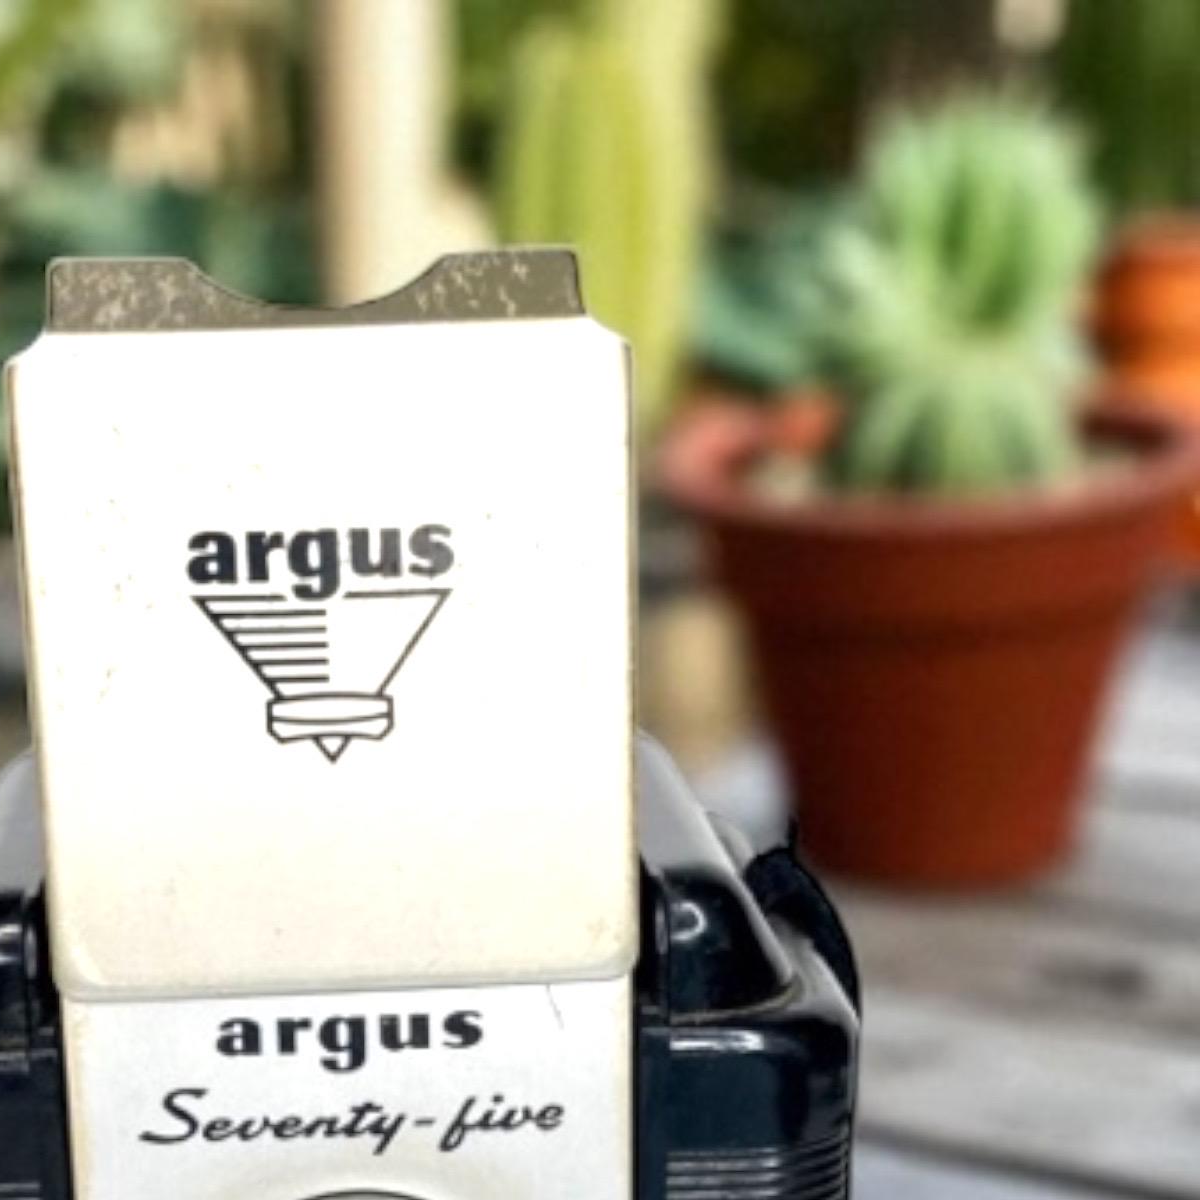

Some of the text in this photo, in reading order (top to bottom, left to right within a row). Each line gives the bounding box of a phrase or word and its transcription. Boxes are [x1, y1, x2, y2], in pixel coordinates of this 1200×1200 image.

[186, 524, 455, 600] argus
[215, 1009, 483, 1073] argus
[139, 1087, 565, 1155] Seventy-five
